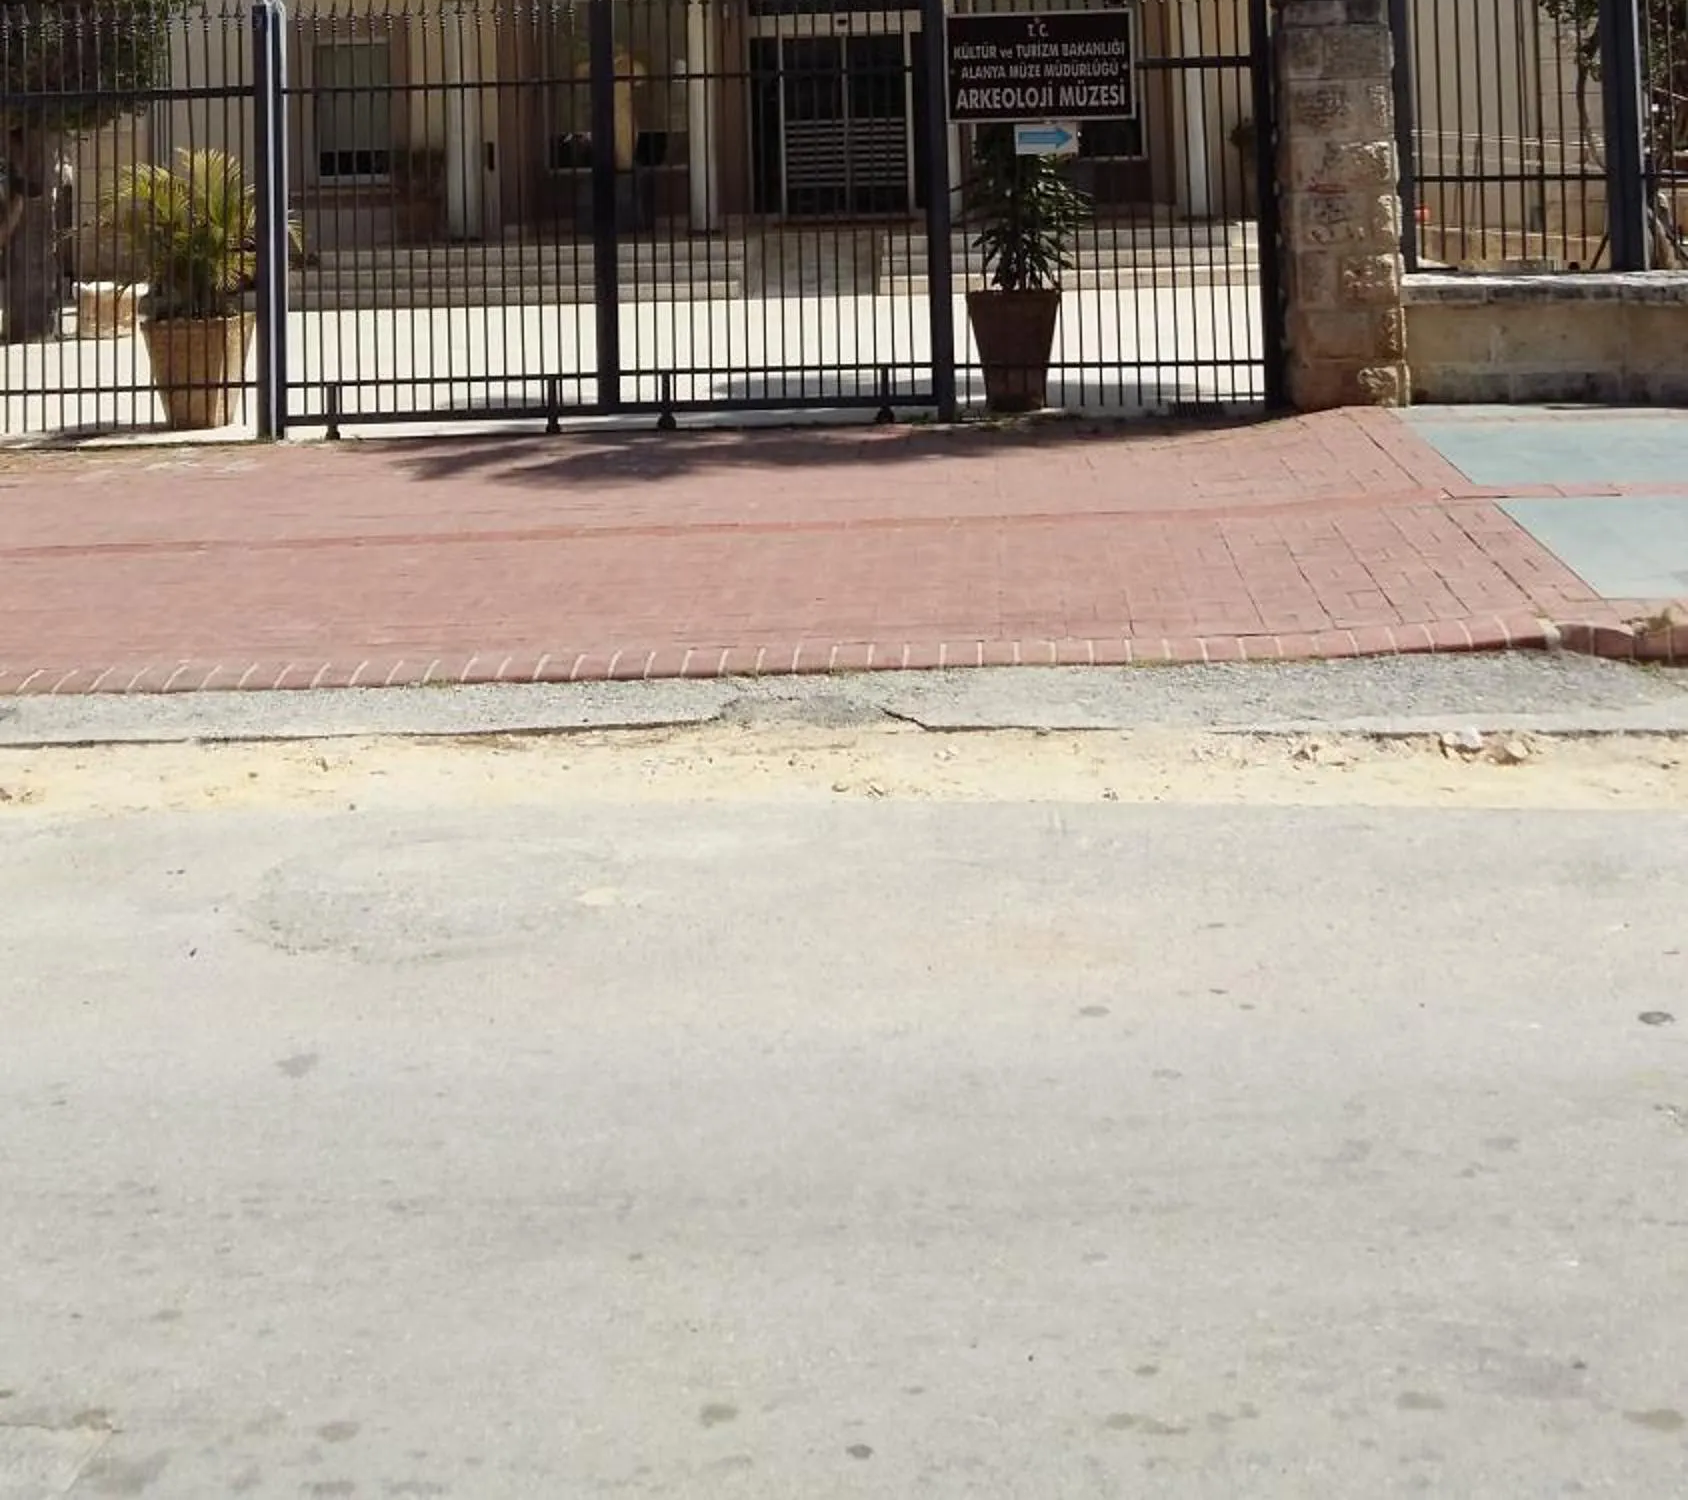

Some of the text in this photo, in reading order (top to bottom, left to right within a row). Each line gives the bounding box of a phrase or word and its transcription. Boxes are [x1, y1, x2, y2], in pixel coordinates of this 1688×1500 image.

[953, 38, 1126, 60] KÜLTÜR ve TURİZM BAKANLIĞI
[961, 58, 1119, 79] ALANYA MÜZE MÜDÜRLÜĞÜ
[955, 77, 1126, 110] ARKEOLOJİ MÜZESİ
